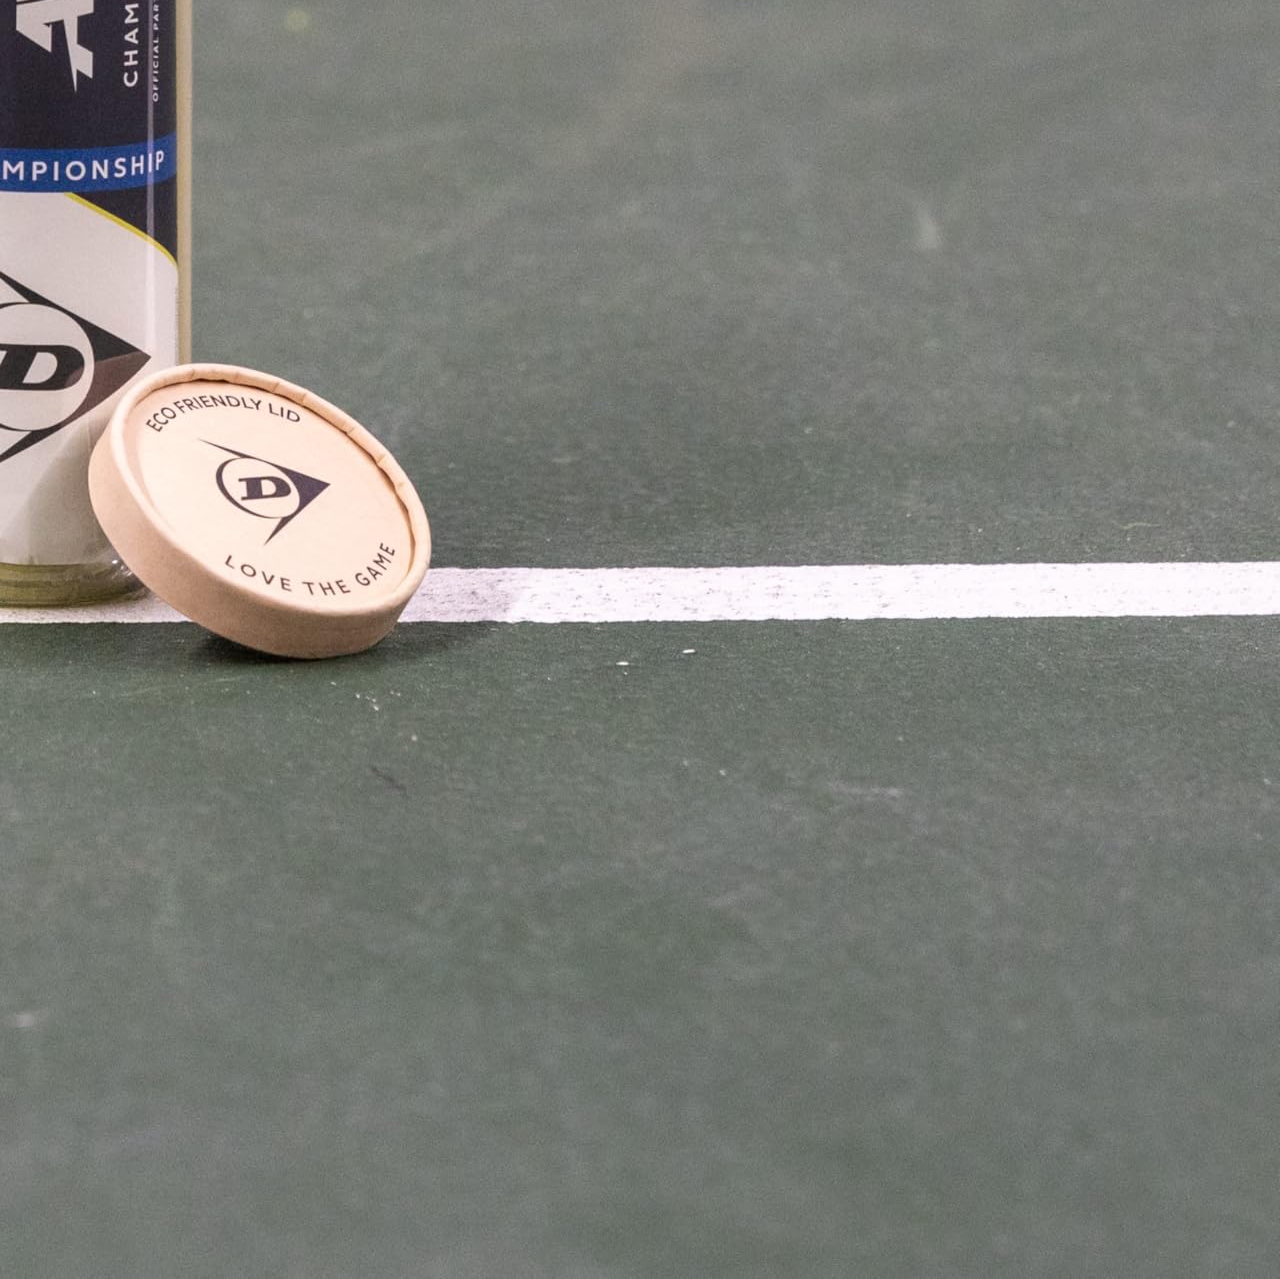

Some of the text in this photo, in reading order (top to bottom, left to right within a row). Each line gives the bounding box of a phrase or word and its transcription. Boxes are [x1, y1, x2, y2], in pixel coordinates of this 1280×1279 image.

[151, 36, 159, 103] OFFICIAL
[145, 394, 302, 433] ECO FRIENDLY LID
[237, 475, 292, 501] D
[224, 542, 396, 597] LOVE THE GAME
